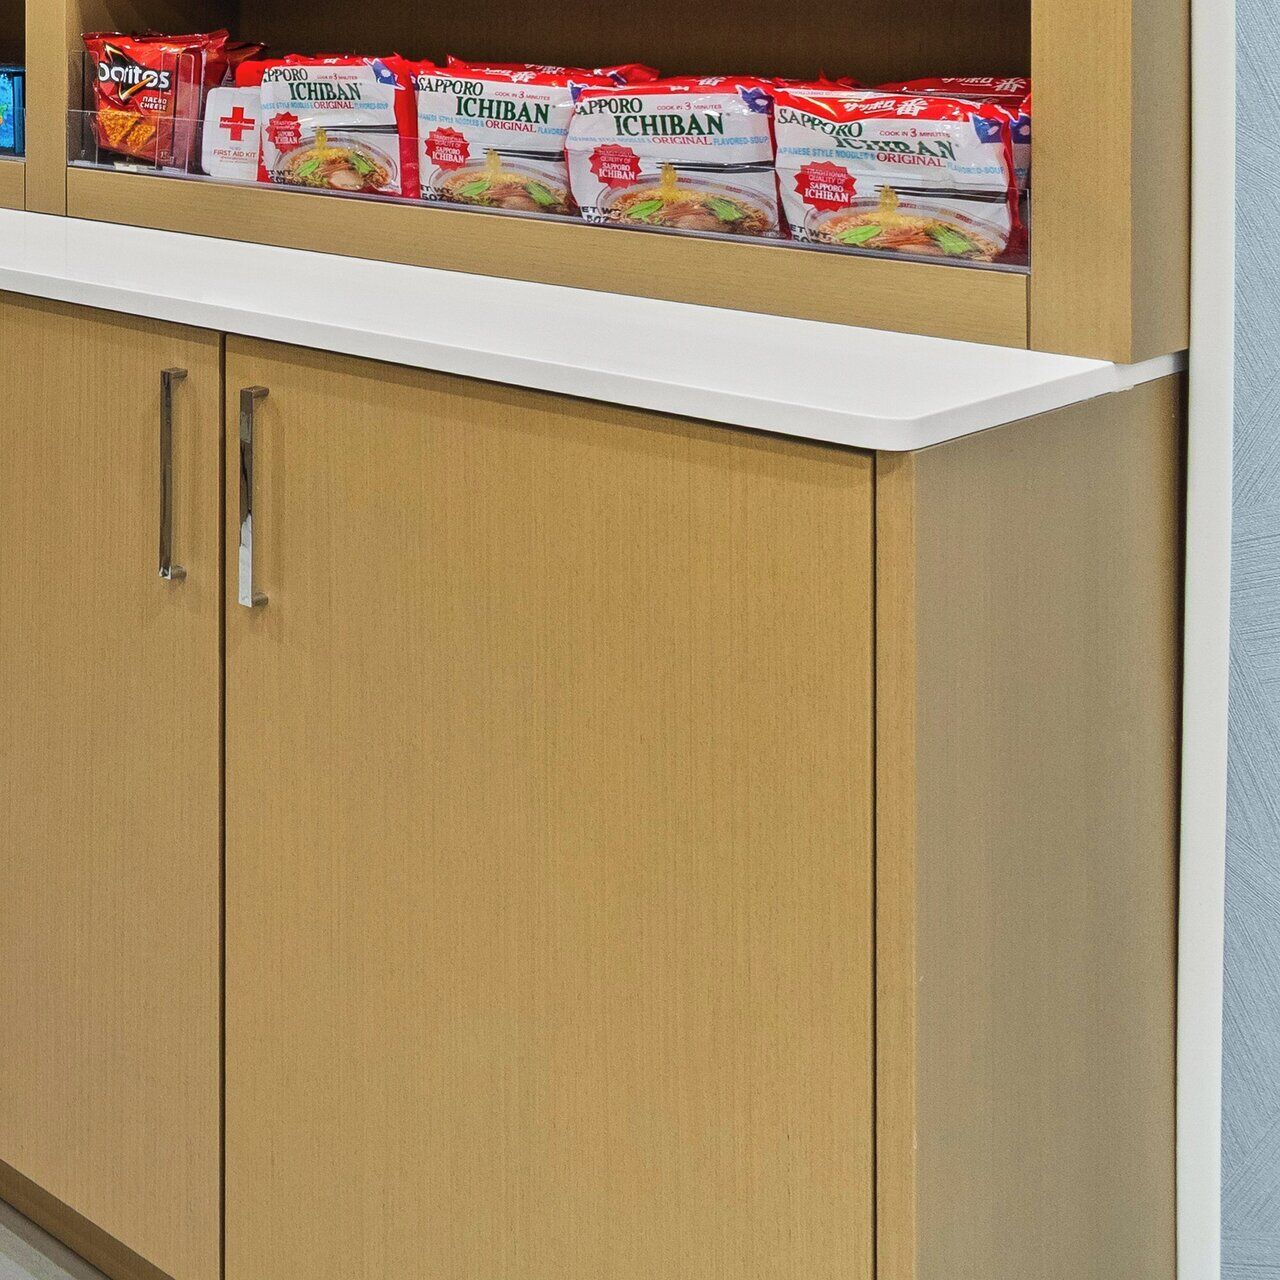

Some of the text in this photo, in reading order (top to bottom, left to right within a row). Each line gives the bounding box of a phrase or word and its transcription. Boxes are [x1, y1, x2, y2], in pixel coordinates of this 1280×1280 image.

[99, 62, 170, 89] Doritos
[264, 67, 308, 83] PPORO
[288, 82, 361, 101] ICHIBAN
[419, 76, 484, 96] SAPPORO
[519, 90, 524, 98] 3
[314, 101, 354, 109] ORIGINAL
[456, 96, 550, 124] ICHIBAN
[685, 102, 691, 110] 3
[485, 120, 536, 133] ORIGINAL
[614, 113, 724, 136] ICHIBAN
[777, 108, 863, 138] SAPPORO
[910, 127, 917, 138] 3
[652, 136, 712, 146] ORIGINAL
[435, 147, 460, 155] SAPPORO
[432, 152, 464, 163] ICHIBAN
[778, 147, 811, 157] APANESE
[813, 148, 833, 158] STYLE
[876, 152, 947, 168] ORIGINAL
[602, 163, 630, 171] SAPPORO
[599, 170, 635, 181] ICHIBAN
[808, 175, 835, 183] QUALITY
[809, 183, 844, 192] SAPPORO
[804, 189, 849, 202] ICHIBAN
